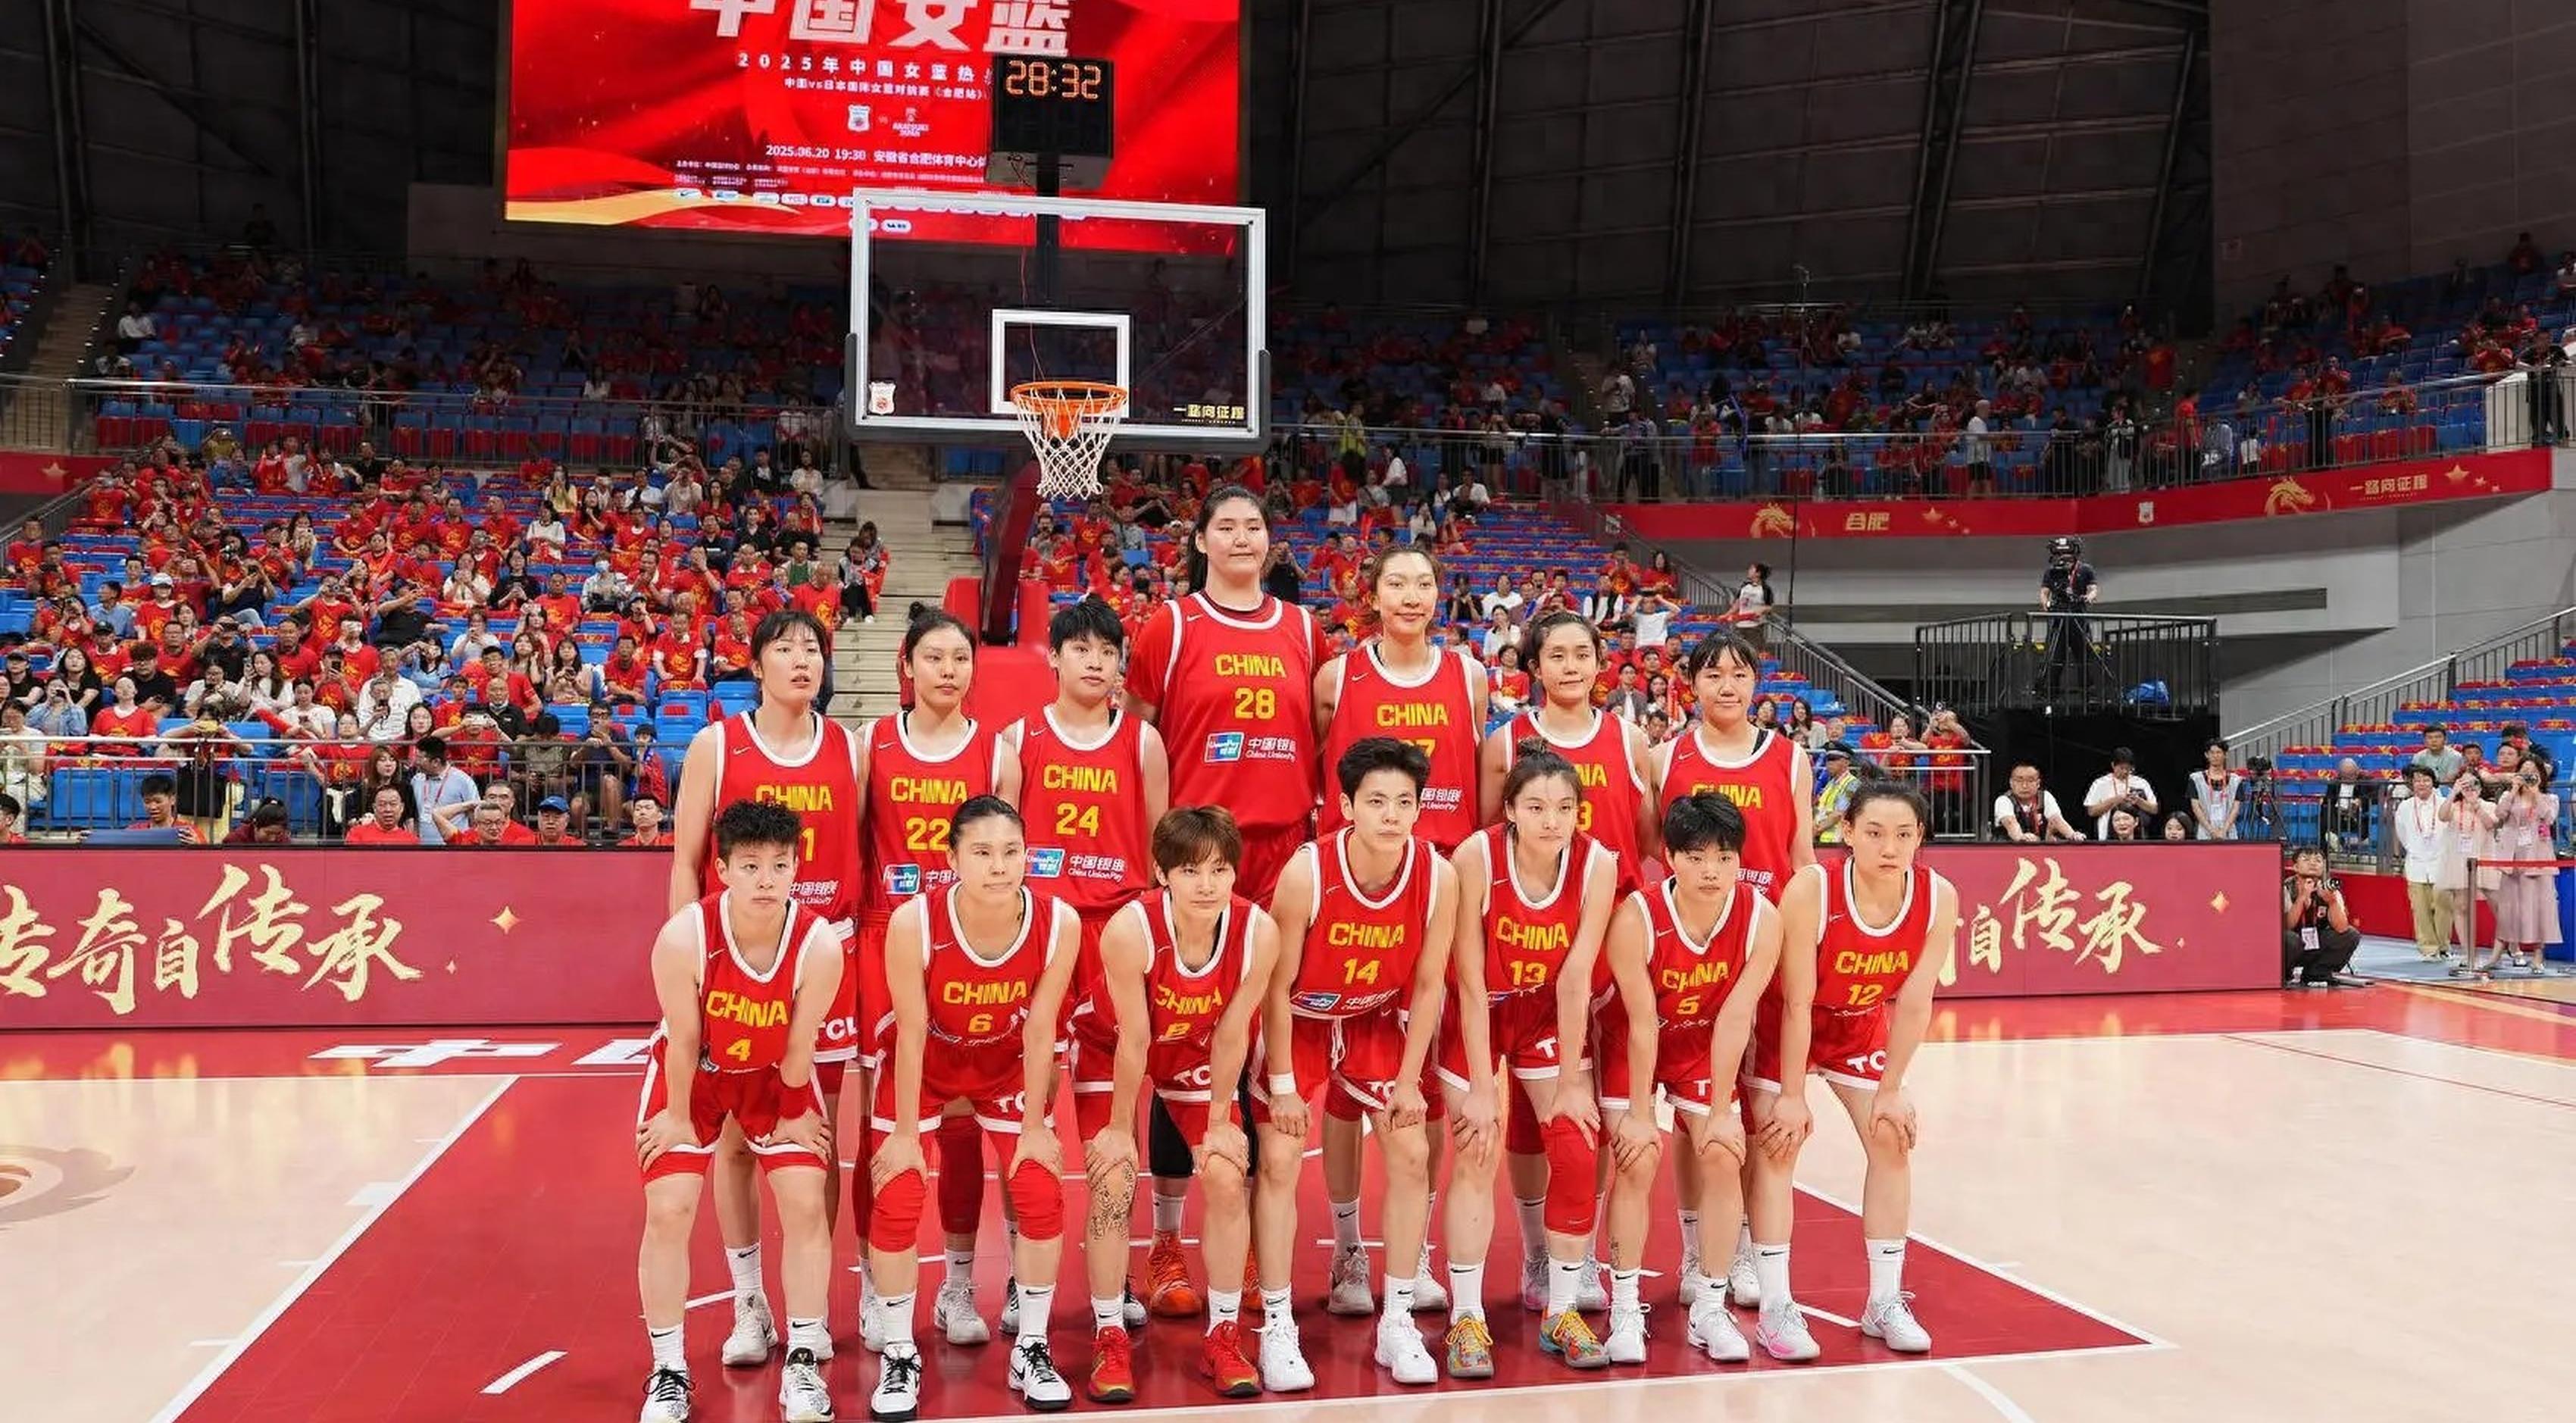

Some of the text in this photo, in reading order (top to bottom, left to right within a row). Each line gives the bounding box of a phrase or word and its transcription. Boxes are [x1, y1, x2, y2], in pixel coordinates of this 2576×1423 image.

[1006, 60, 1101, 99] 28:32
[766, 145, 830, 158] 2025.06.20
[1846, 512, 1890, 531] 合肥
[1215, 654, 1286, 678] CHINA
[1234, 686, 1275, 719] 28
[1377, 703, 1449, 727] CHINA
[1399, 739, 1436, 758] 7
[890, 777, 968, 805] CHINA
[1043, 765, 1118, 793] CHINA
[1055, 802, 1099, 837] 24
[1576, 801, 1592, 831] 3
[802, 827, 815, 862] 1
[906, 817, 950, 851] 22
[1329, 922, 1405, 948] CHINA
[1496, 916, 1569, 951] CHINA
[1938, 857, 2165, 987] 自传承
[1343, 958, 1380, 984] 14
[1509, 960, 1547, 986] 13
[1835, 950, 1909, 974] CHINA
[1662, 962, 1730, 993] CHINA
[943, 981, 1029, 1005] CHINA
[1154, 985, 1223, 1015] CHINA
[1676, 995, 1700, 1015] 5
[1847, 984, 1884, 1005] 12
[705, 990, 788, 1027] CHINA
[818, 1016, 858, 1040] CL
[968, 1013, 993, 1033] 6
[727, 1038, 752, 1062] 4
[1846, 1050, 1886, 1073] TC
[1174, 1065, 1211, 1087] TC
[1366, 1080, 1396, 1098] TC
